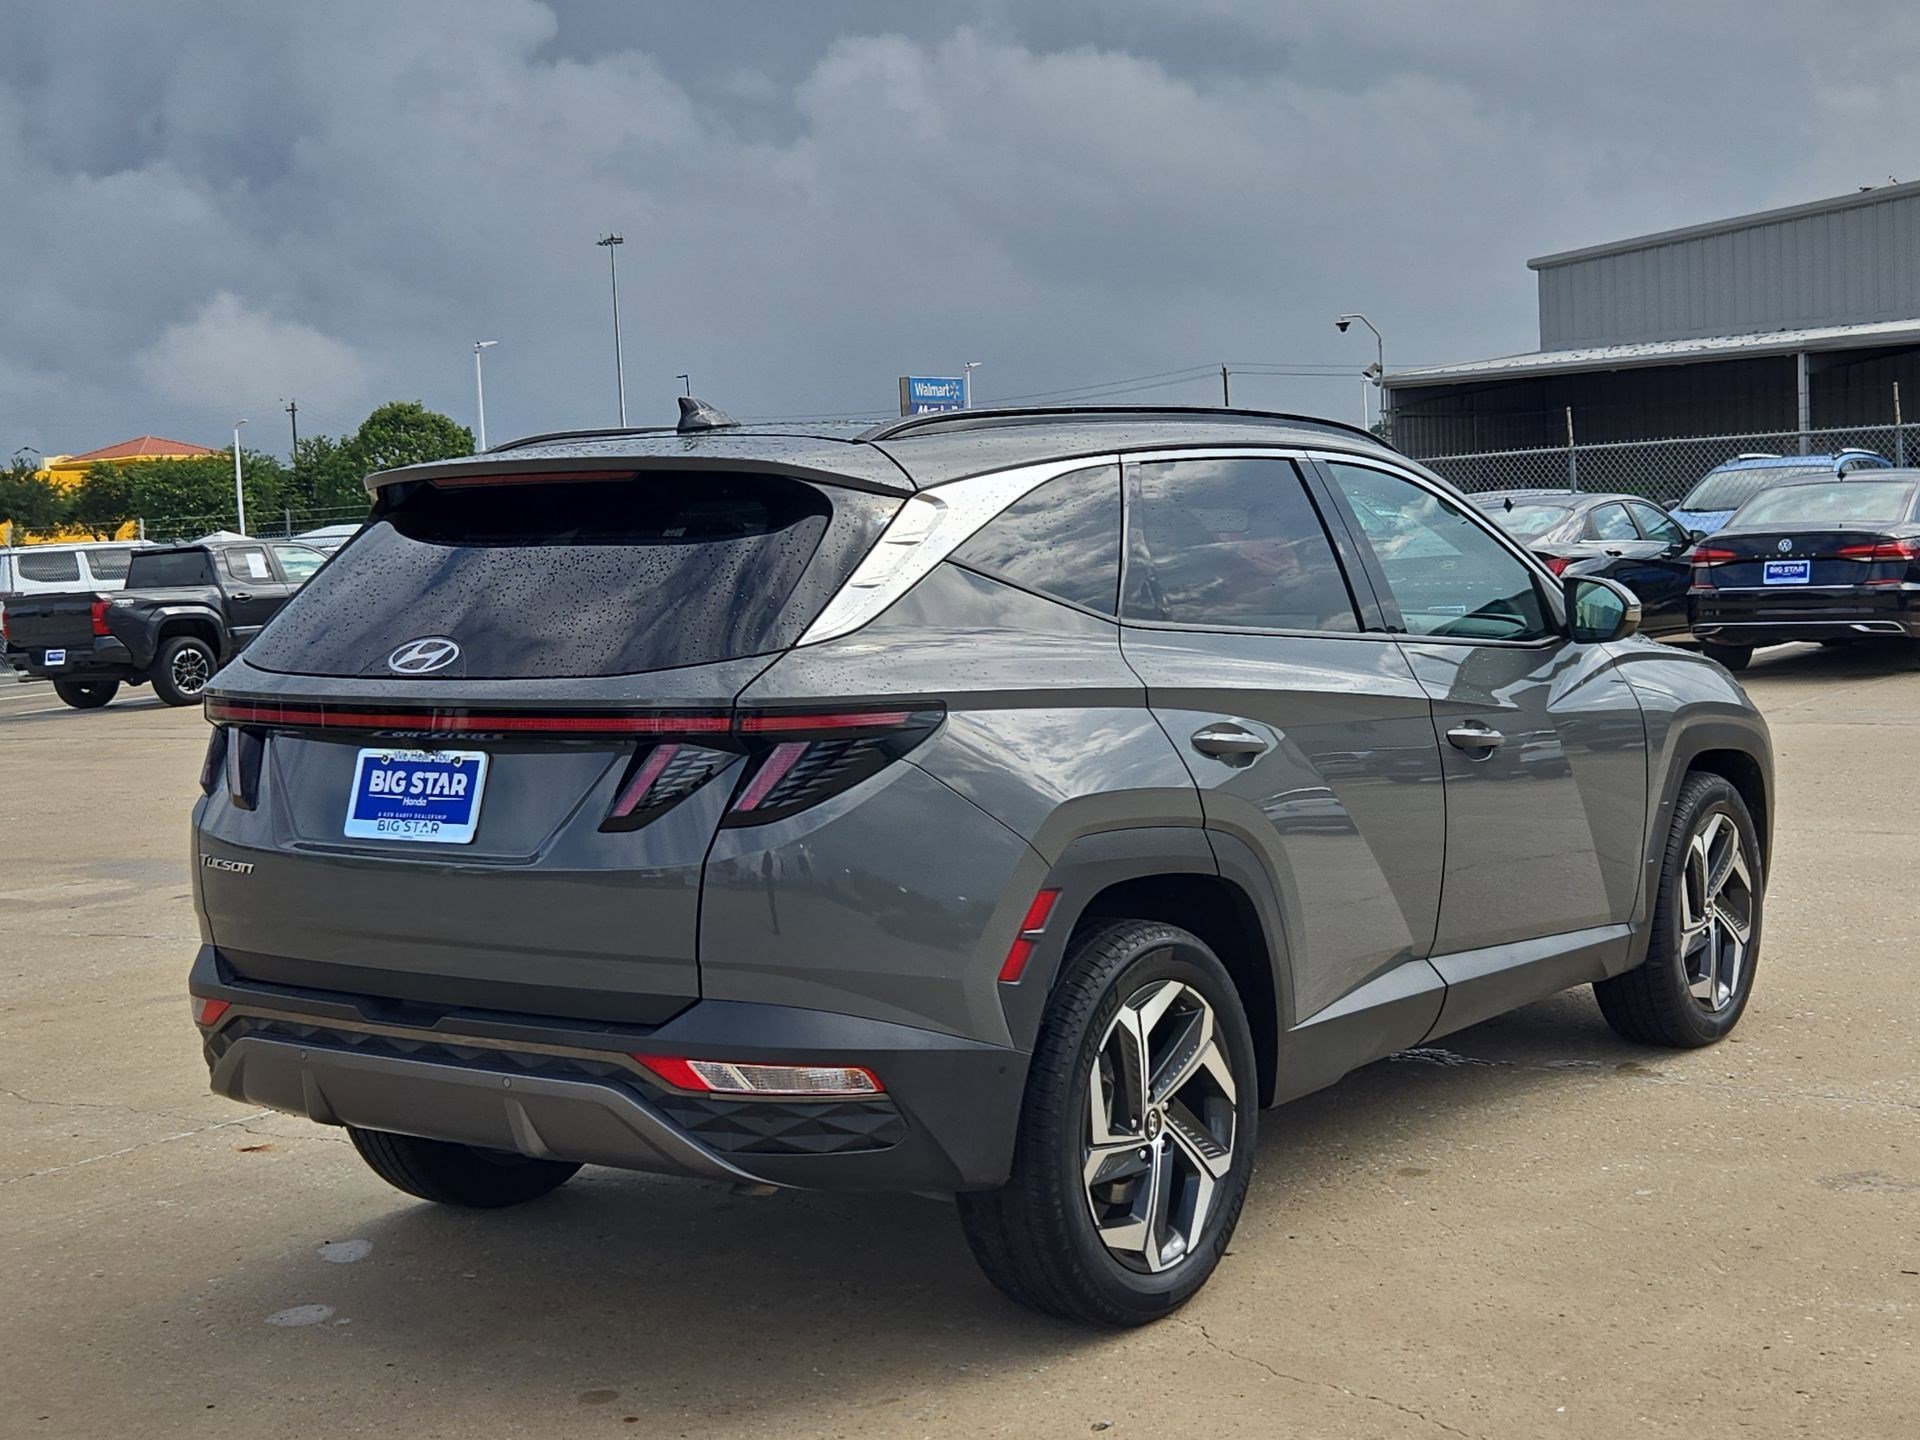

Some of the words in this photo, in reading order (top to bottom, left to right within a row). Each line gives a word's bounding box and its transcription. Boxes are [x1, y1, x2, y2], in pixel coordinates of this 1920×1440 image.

[914, 382, 950, 397] Walmart
[1769, 566, 1783, 574] BIG
[1784, 565, 1805, 573] STAR
[369, 769, 407, 794] BIG
[409, 771, 468, 796] STAR
[402, 796, 427, 806] Honda
[377, 820, 400, 832] BIG
[403, 821, 440, 834] STAR
